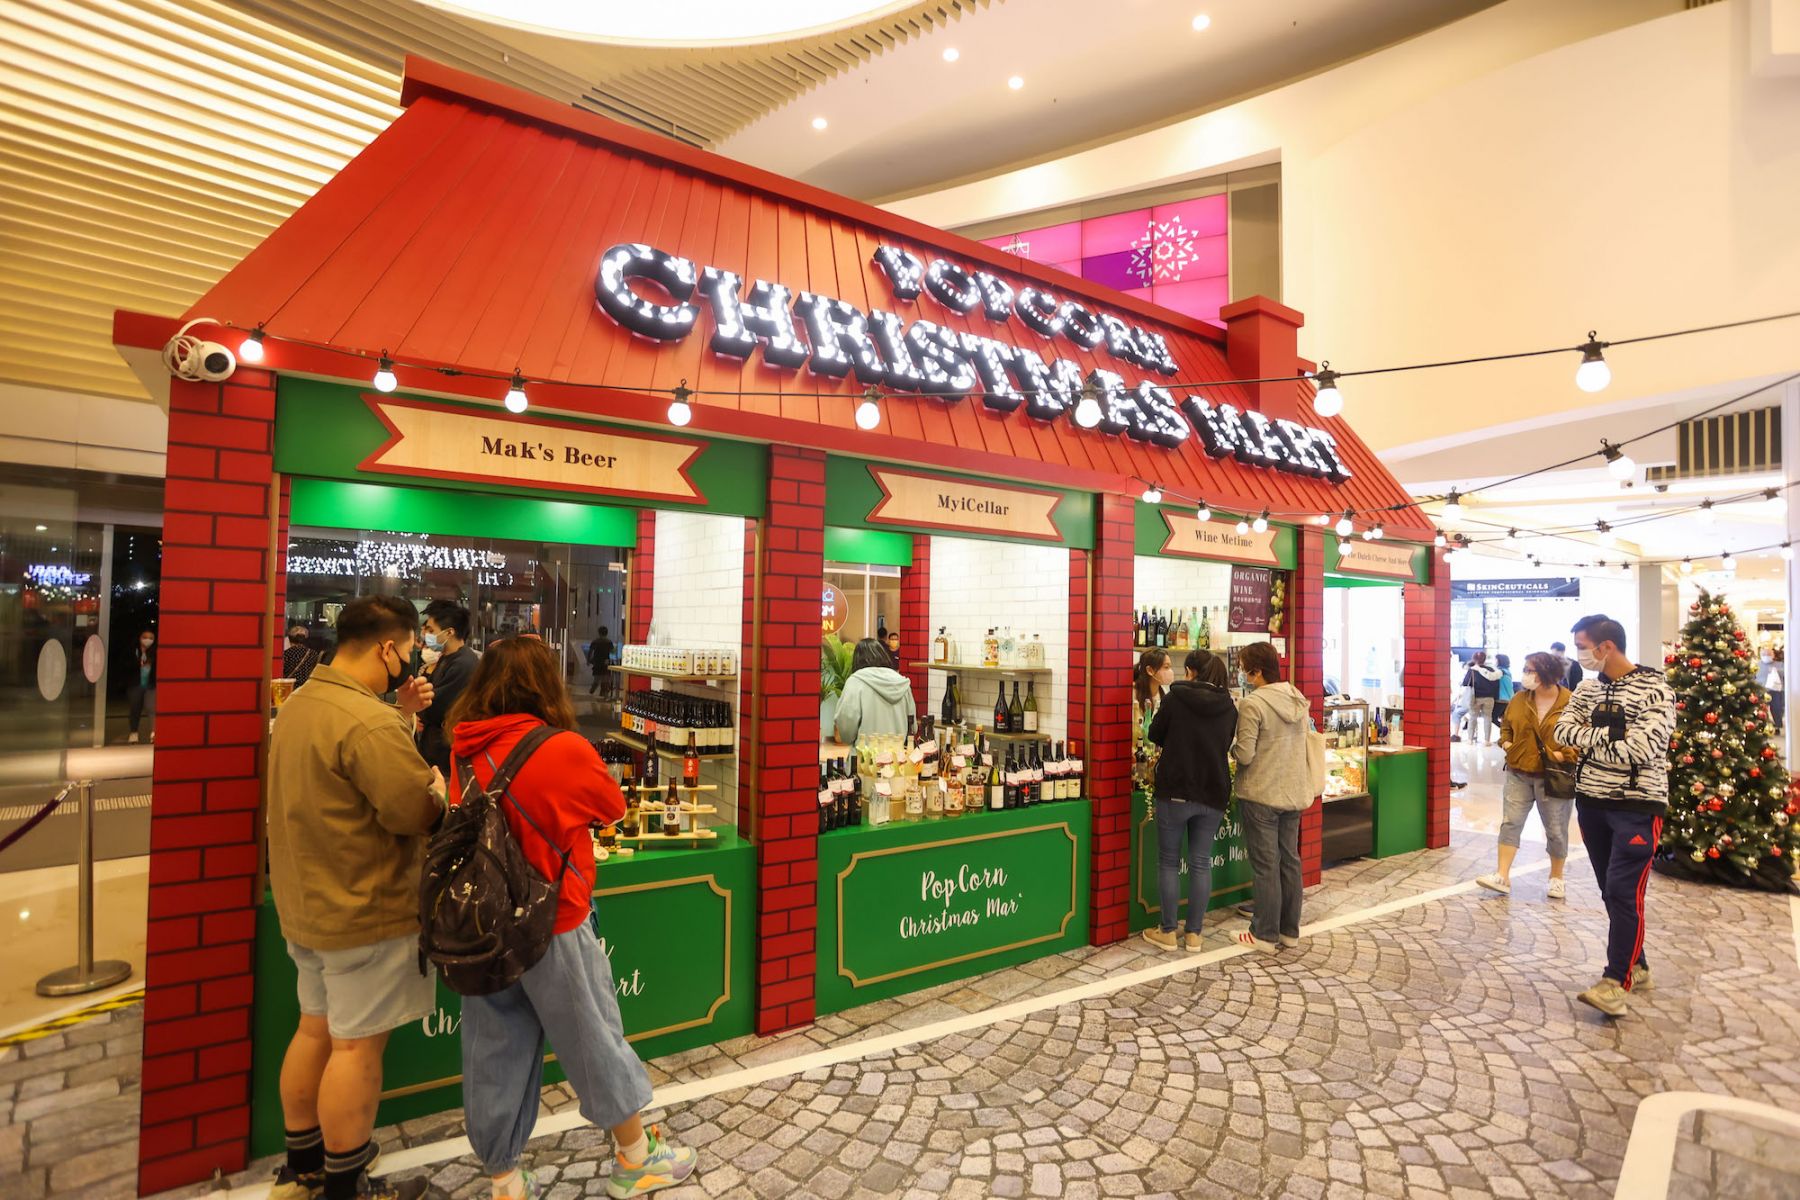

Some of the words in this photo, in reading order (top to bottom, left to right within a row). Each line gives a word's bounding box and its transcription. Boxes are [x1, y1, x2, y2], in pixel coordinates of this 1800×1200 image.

[873, 245, 1180, 377] POPCORN
[595, 242, 1190, 450] CHRISTMAS
[1180, 394, 1353, 486] MART
[481, 435, 555, 462] Mak's
[564, 446, 617, 469] Beer
[937, 494, 1009, 516] MyiCellar
[1195, 529, 1219, 544] Wine
[1221, 533, 1253, 548] Metime
[1233, 571, 1268, 583] ORGANIC
[1233, 585, 1254, 595] WINE
[921, 864, 1008, 907] PopCorn
[900, 909, 981, 939] Christmas
[986, 893, 1023, 918] Mar
